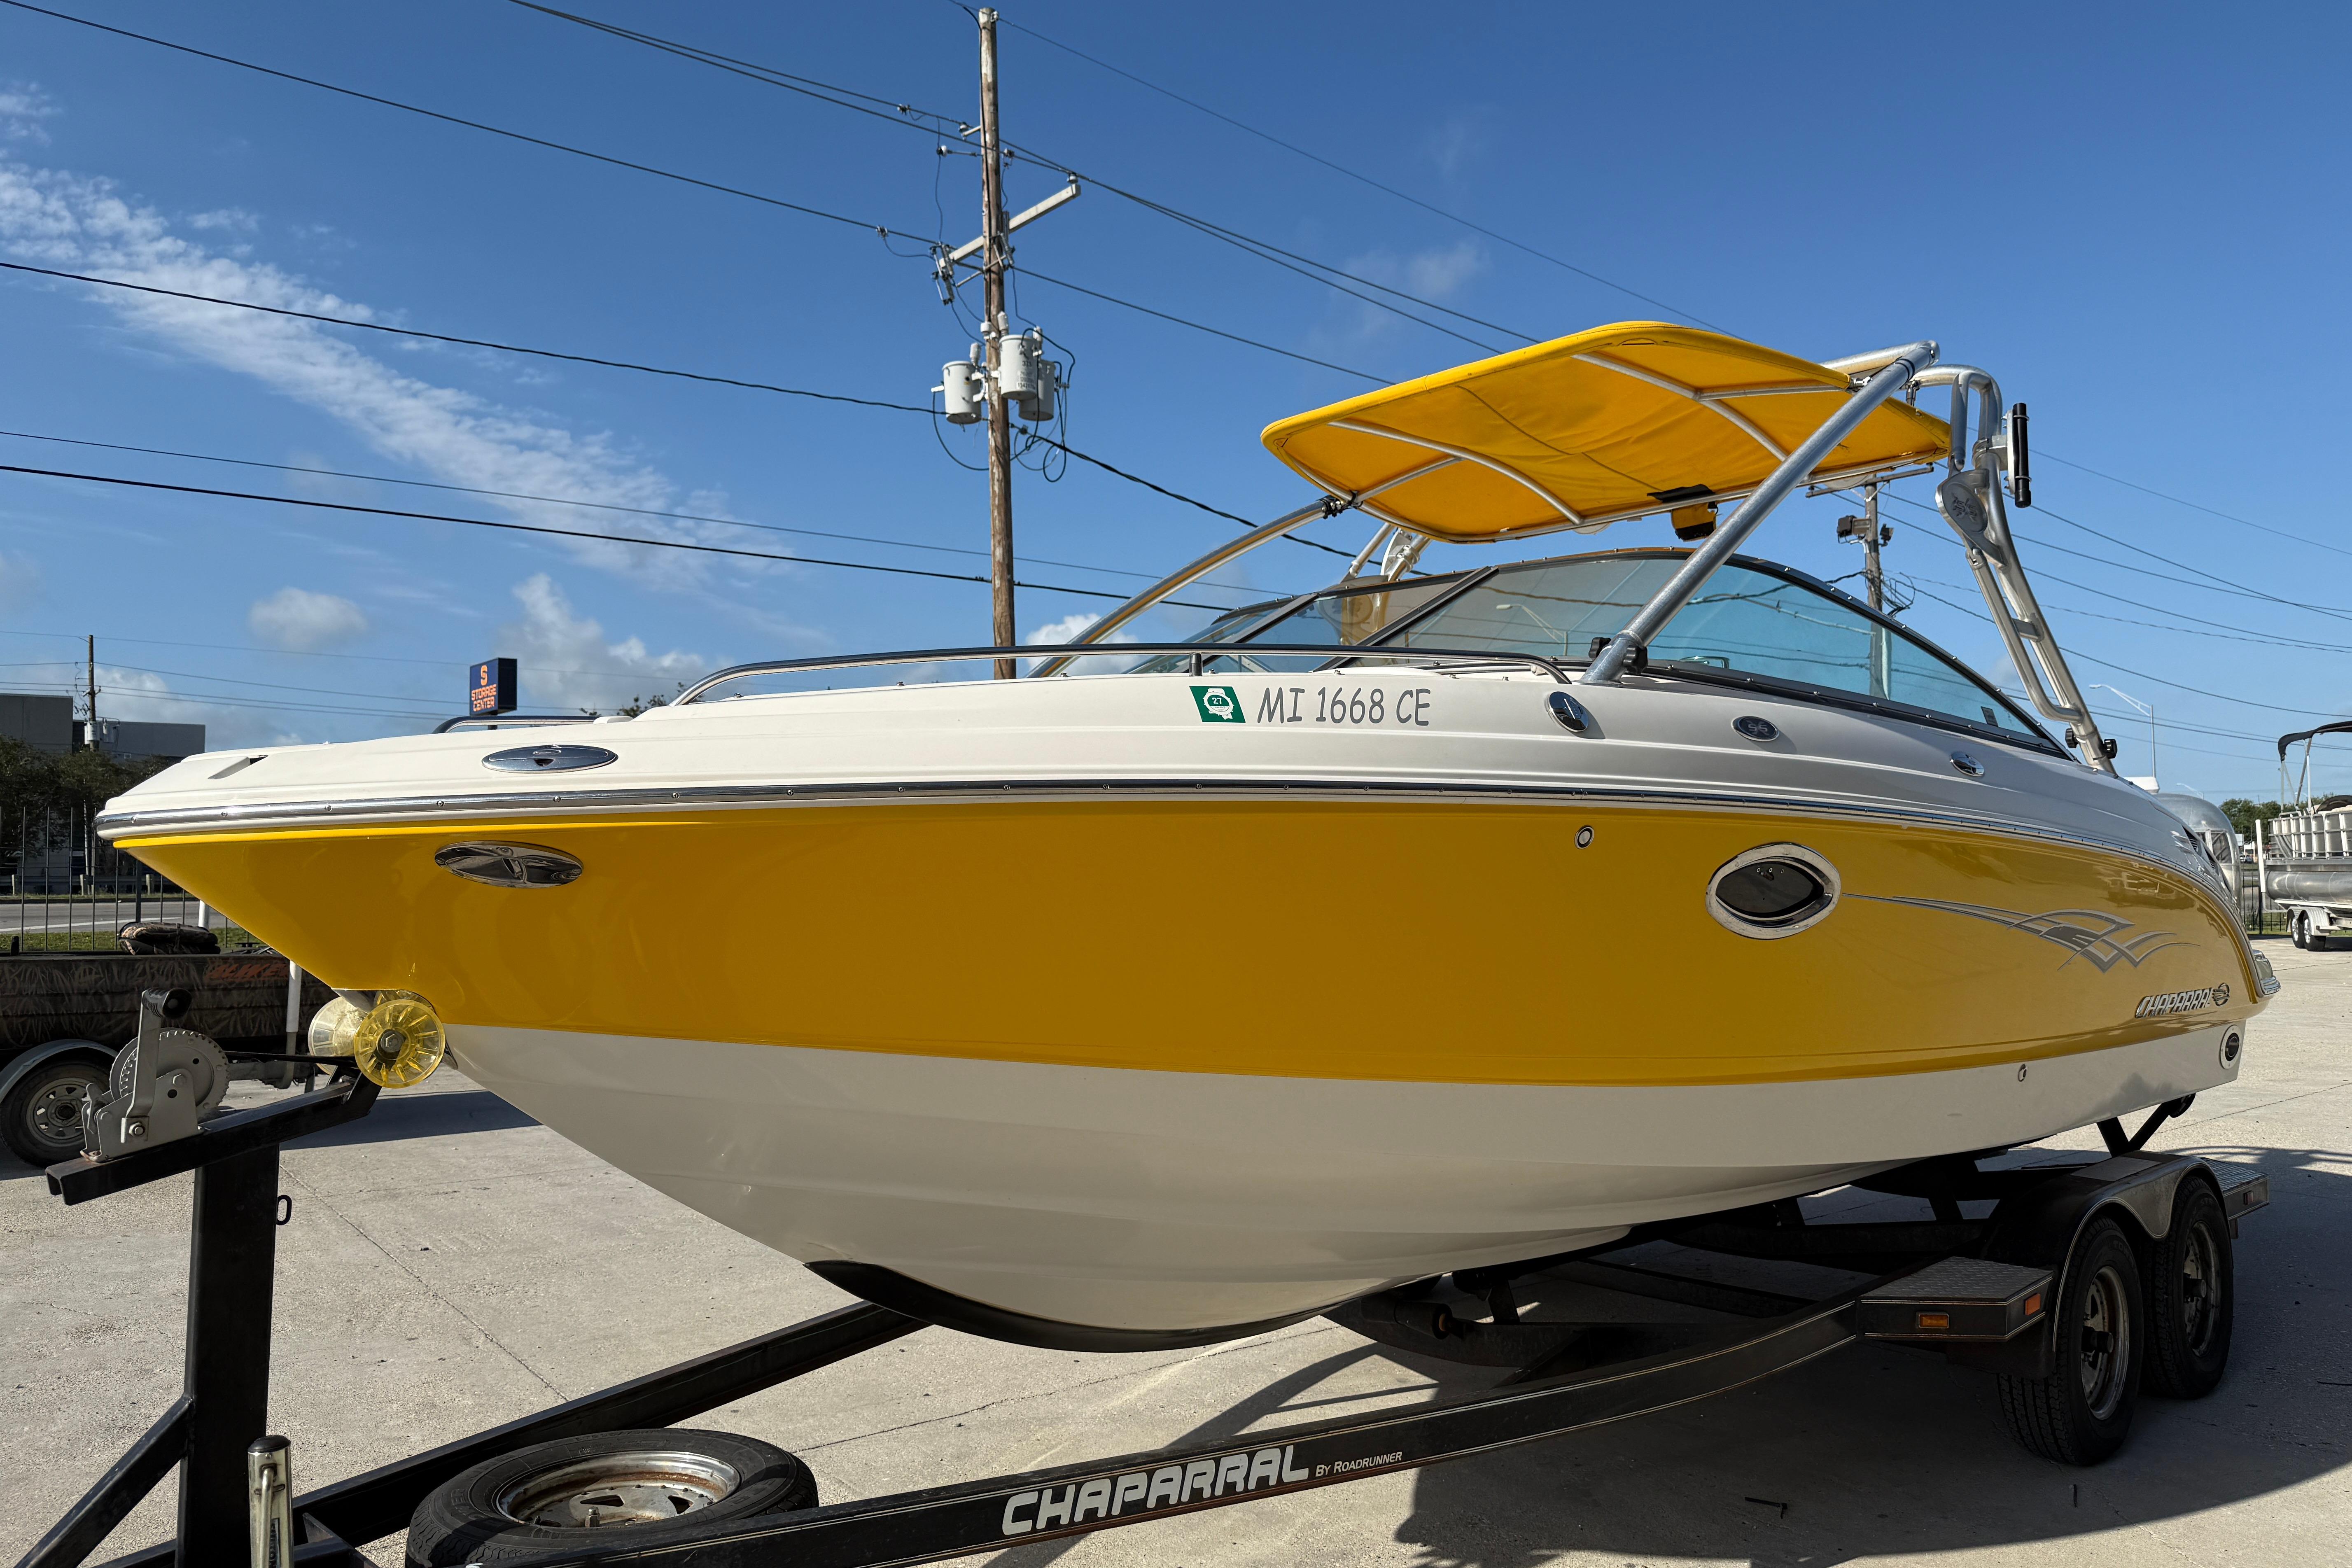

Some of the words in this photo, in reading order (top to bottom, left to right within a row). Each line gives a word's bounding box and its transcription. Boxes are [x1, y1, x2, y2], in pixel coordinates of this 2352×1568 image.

[471, 684, 497, 700] STORAGE
[473, 696, 495, 712] CENTER
[1257, 687, 1305, 724] MI
[1316, 687, 1385, 724] 1668
[1396, 688, 1431, 726] CE
[2135, 987, 2214, 1018] CHAPARRAL
[1002, 1445, 1309, 1535] CHAPARRAL
